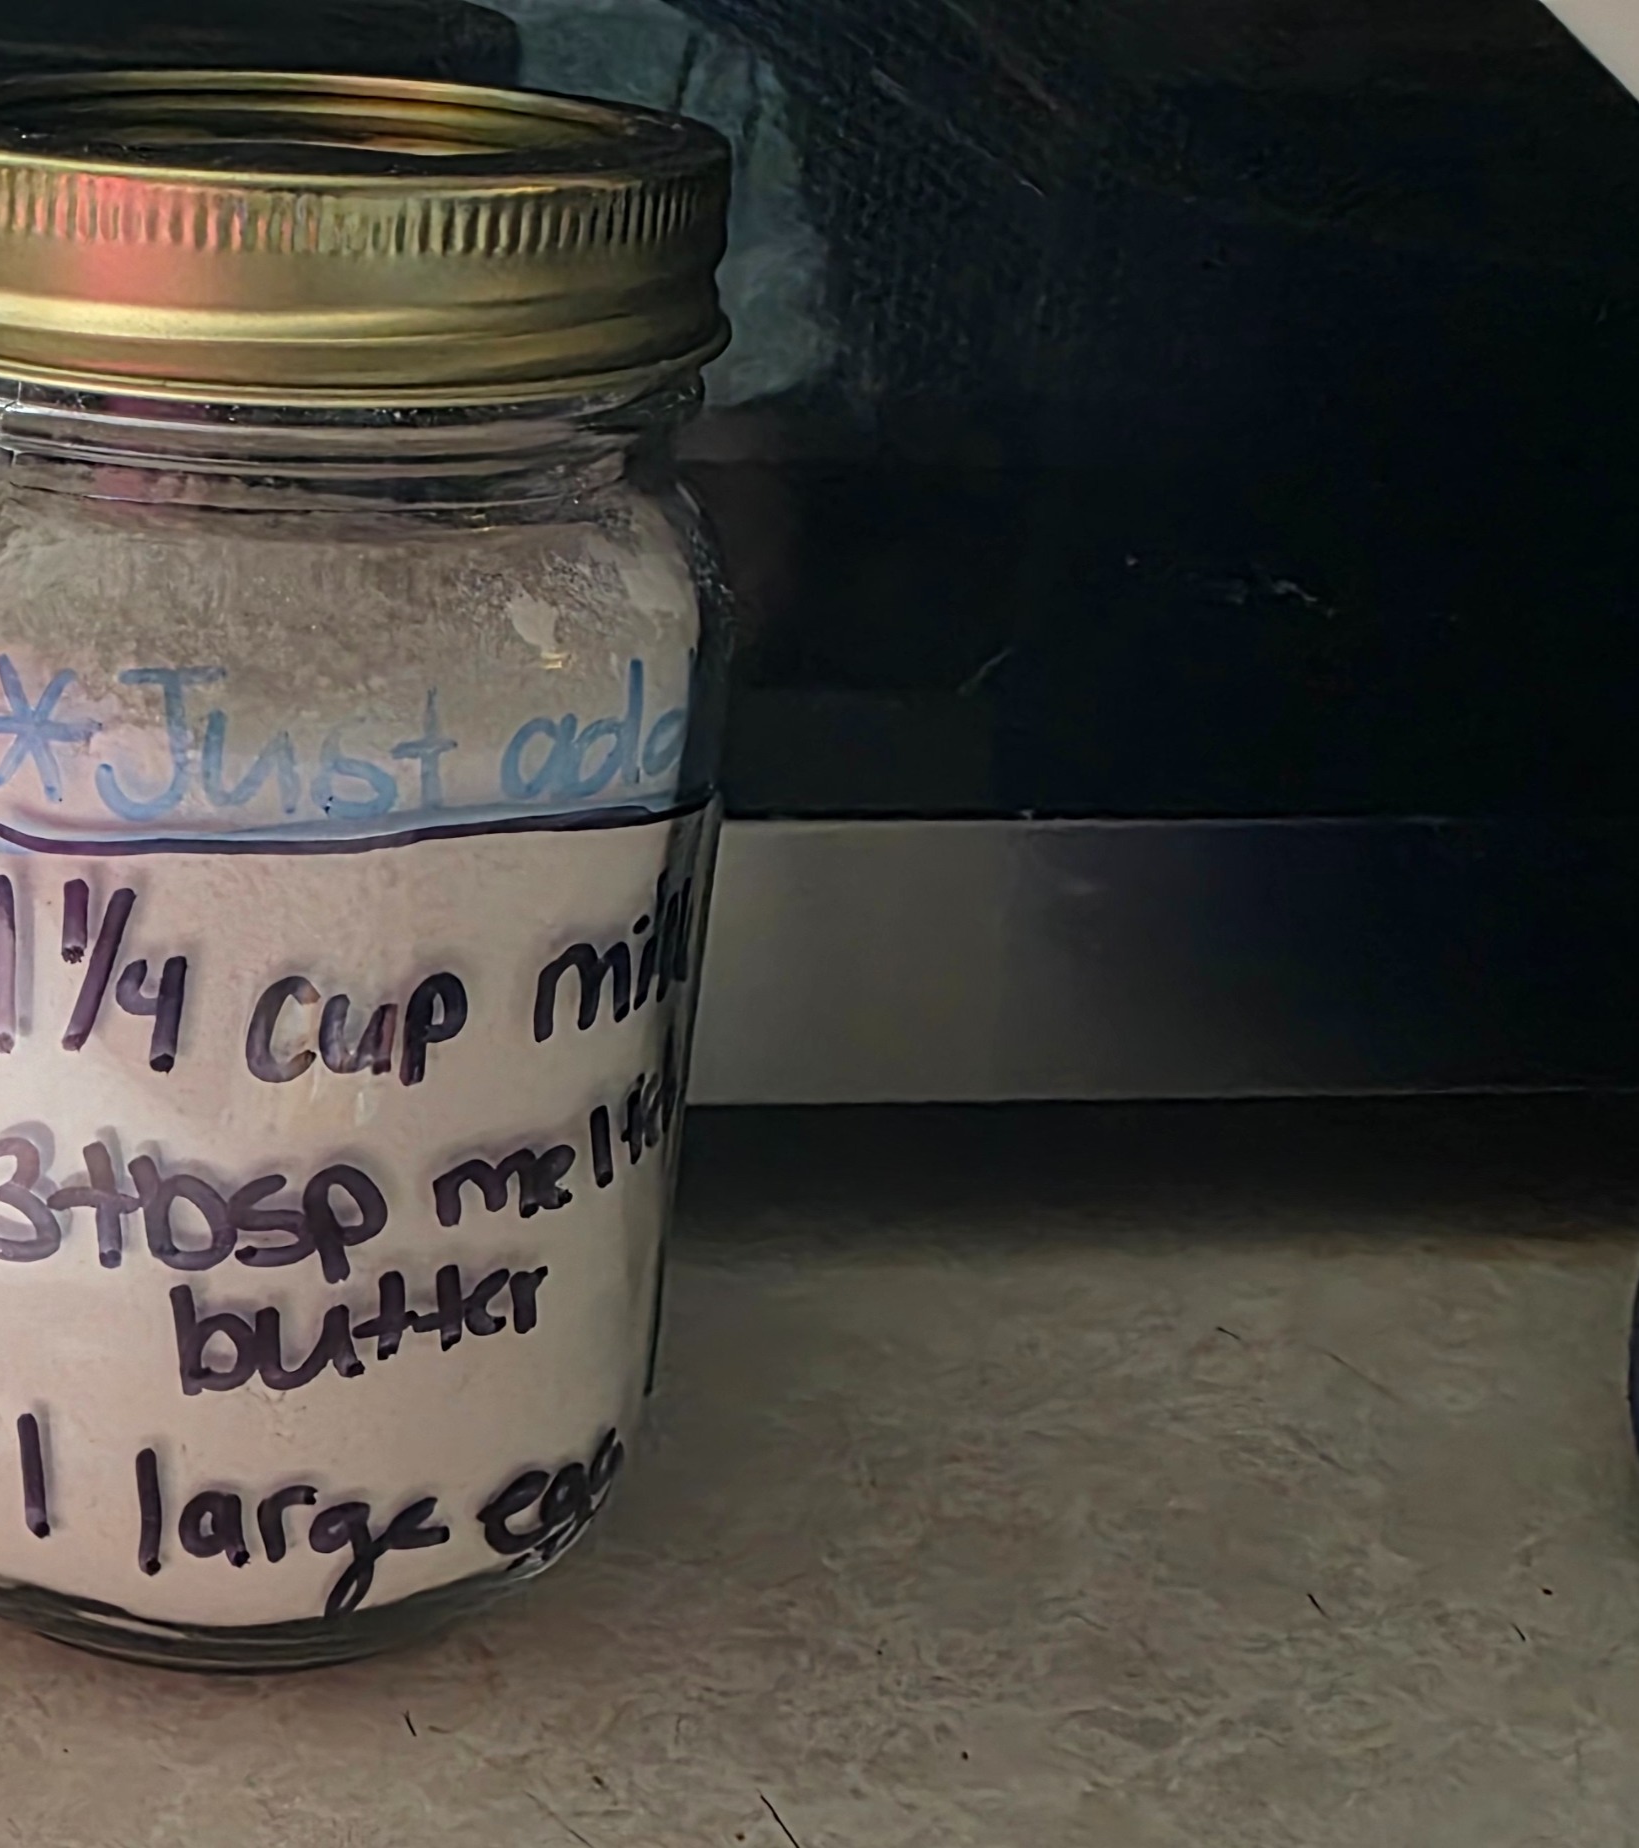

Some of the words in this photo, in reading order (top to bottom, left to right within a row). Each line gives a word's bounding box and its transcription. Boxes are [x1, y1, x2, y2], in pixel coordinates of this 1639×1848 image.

[245, 970, 469, 1087] cup
[169, 1264, 549, 1396] butter
[17, 1413, 50, 1539] 1
[136, 1447, 451, 1620] large
